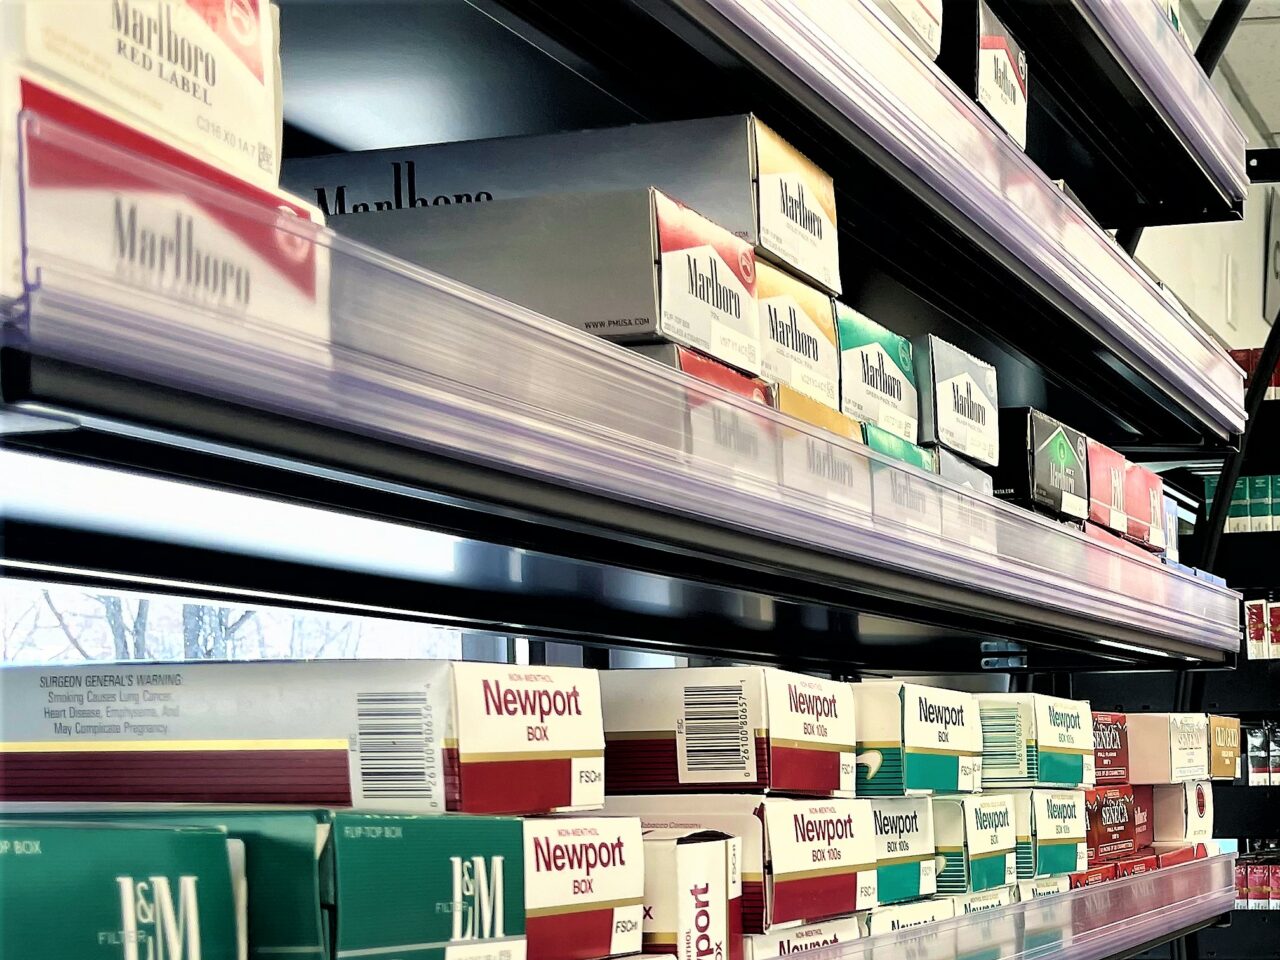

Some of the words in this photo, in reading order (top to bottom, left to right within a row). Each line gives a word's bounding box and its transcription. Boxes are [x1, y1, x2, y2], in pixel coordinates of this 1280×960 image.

[117, 38, 152, 72] RED
[158, 55, 213, 106] LABEL
[779, 178, 823, 241] Marlboro
[686, 254, 741, 319] Marlboro
[584, 317, 650, 330] WWW.PMUSA.COM
[768, 305, 819, 362] Marlboro
[861, 351, 902, 402] Marlboro
[952, 382, 986, 427] Marlboro
[40, 674, 82, 688] SURGEON
[85, 673, 134, 687] GENERAL'S
[48, 691, 84, 705] Smoking
[87, 690, 117, 703] Causes
[119, 690, 140, 704] Lung
[482, 679, 582, 722] Newport
[788, 684, 838, 722] Newport
[44, 707, 67, 719] Heart
[738, 695, 748, 727] 80657
[919, 696, 964, 731] Newport
[54, 722, 72, 735] May
[75, 722, 121, 735] Complicate
[527, 726, 549, 741] BOX
[804, 723, 815, 735] BOX
[816, 725, 828, 737] 100s
[938, 731, 949, 743] BOX
[740, 729, 750, 762] 26100
[874, 810, 919, 839] Newport
[1102, 805, 1128, 826] SENECA
[385, 826, 403, 838] BOX
[793, 814, 854, 846] Newport
[15, 841, 41, 854] BOX
[533, 837, 625, 876] Newport
[812, 850, 826, 862] BOX
[827, 849, 841, 861] 100s
[887, 841, 898, 853] BOX
[899, 841, 910, 851] 100s
[573, 879, 594, 895] BOX
[435, 902, 469, 913] FILTER
[450, 856, 505, 941] L&M
[98, 930, 147, 944] FILTER
